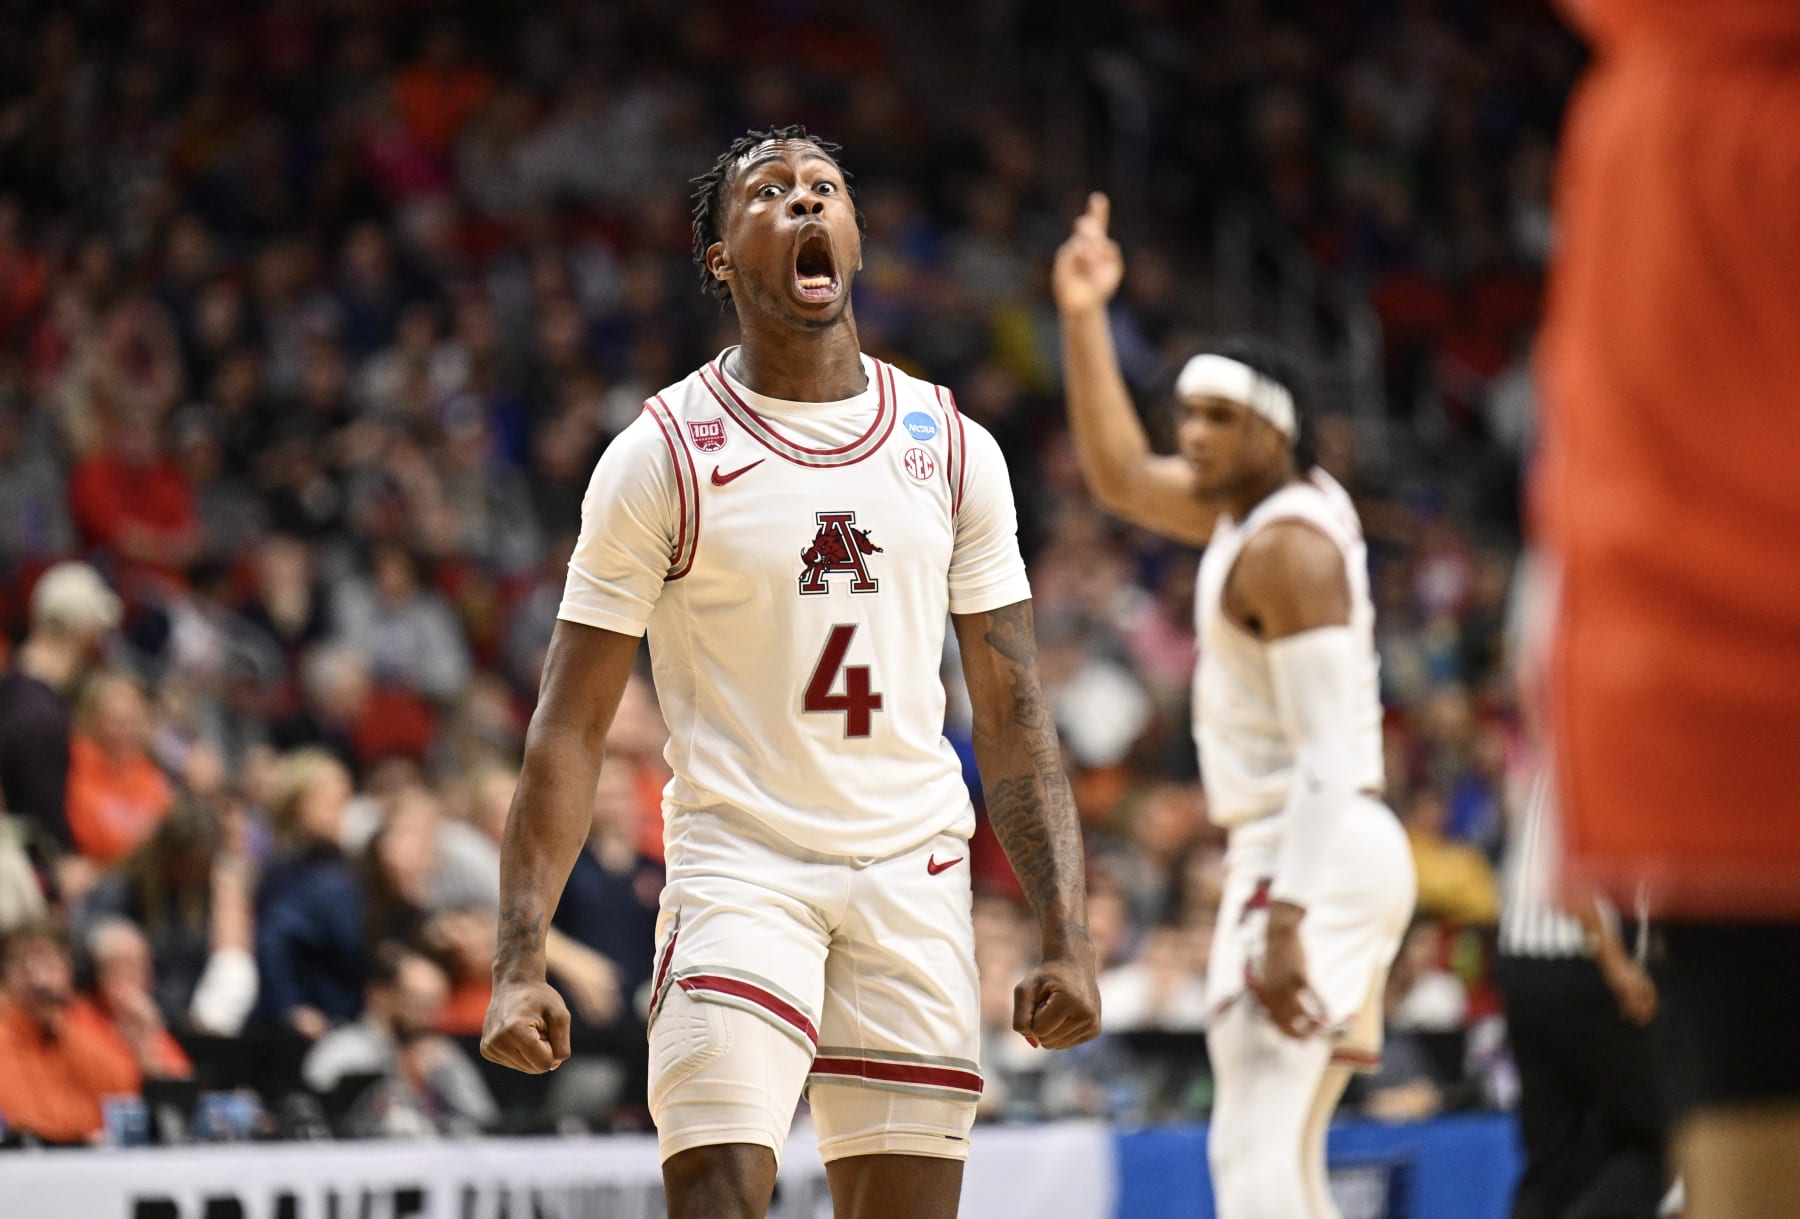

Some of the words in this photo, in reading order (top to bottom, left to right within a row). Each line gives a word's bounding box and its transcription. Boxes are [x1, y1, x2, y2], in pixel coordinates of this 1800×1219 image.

[693, 423, 720, 437] 100
[908, 423, 936, 435] NCAA
[904, 448, 934, 480] SEC
[799, 511, 879, 595] A
[802, 623, 883, 739] 4
